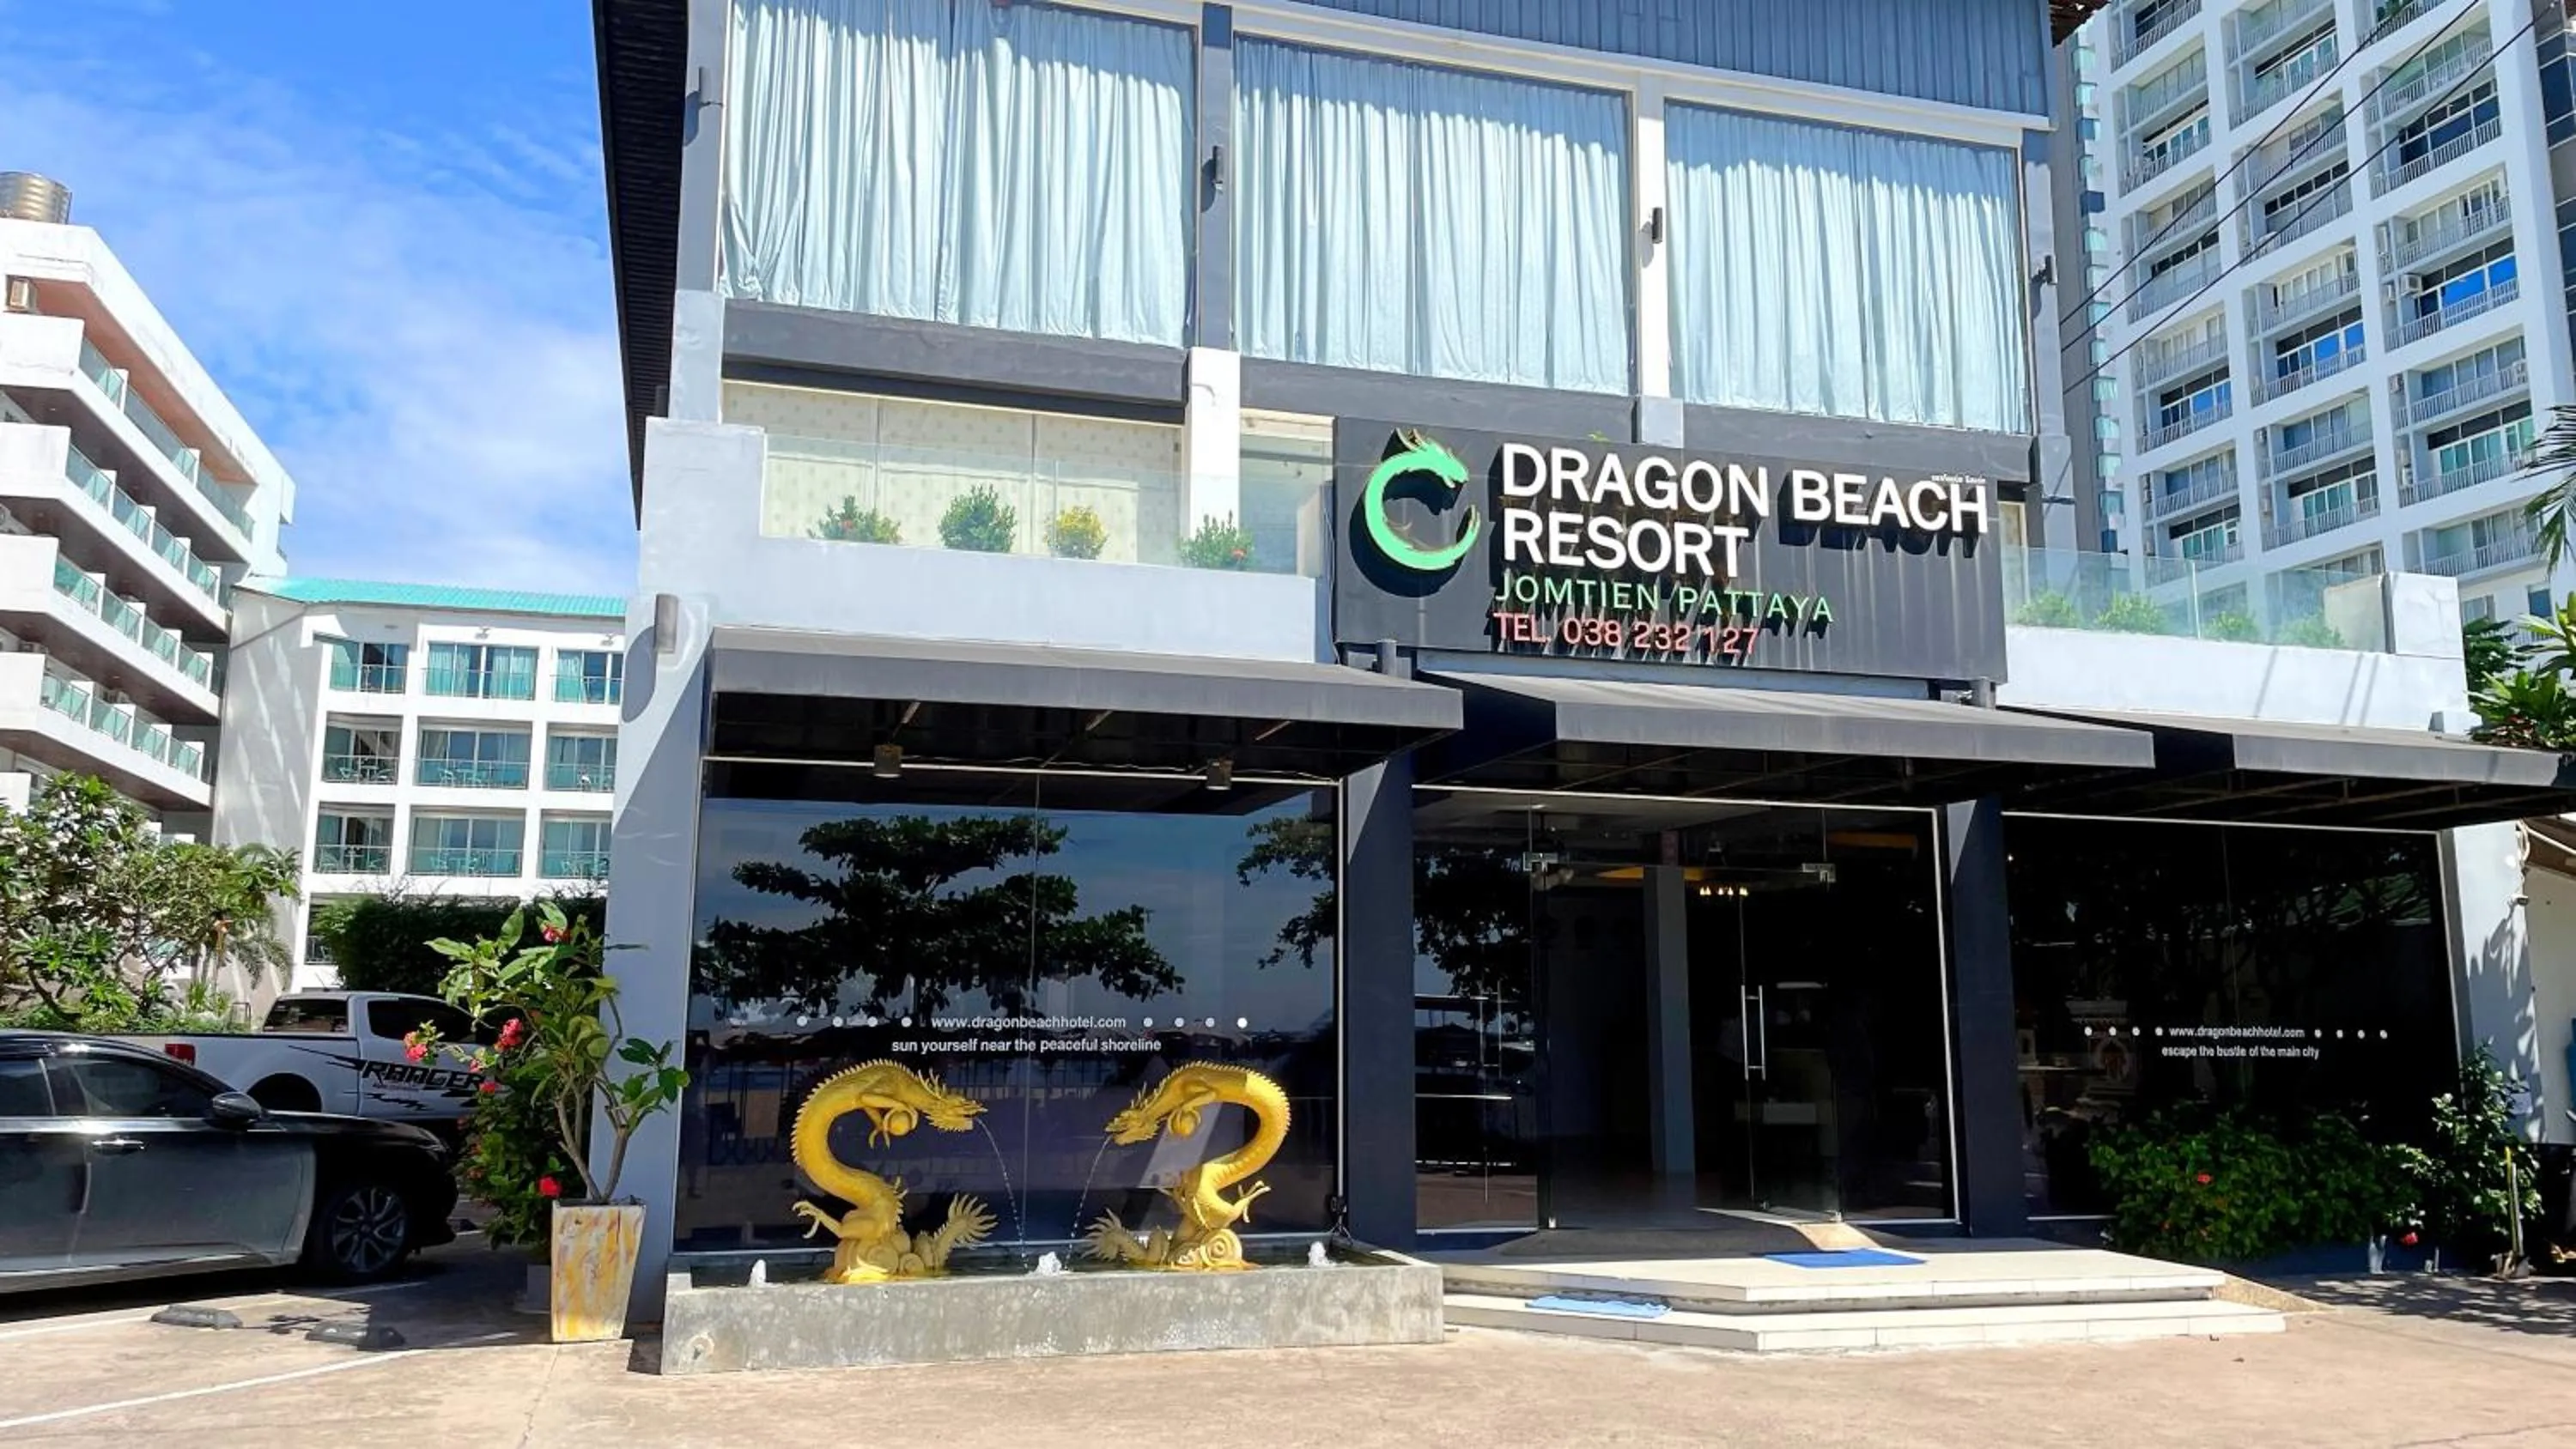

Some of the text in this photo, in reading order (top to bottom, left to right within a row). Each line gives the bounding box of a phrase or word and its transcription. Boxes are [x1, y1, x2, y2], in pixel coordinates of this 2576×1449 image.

[1502, 442, 1990, 534] DRAGON BEACH
[1502, 513, 1750, 579] RESORT
[1494, 574, 1834, 623] JOMTIEN PATTAYA
[1563, 617, 1623, 649] 038
[1633, 621, 1690, 652] 232
[1702, 626, 1760, 655] 127
[932, 1016, 1127, 1030] www.dragonbeachhotel.com
[2169, 1025, 2306, 1040] www.dragonbeachhotel.com
[891, 1037, 1162, 1055] sun yourself near the peaceful shoreline
[2161, 1045, 2319, 1060] escape the bustle of the main city
[362, 1059, 486, 1090] RANGER
